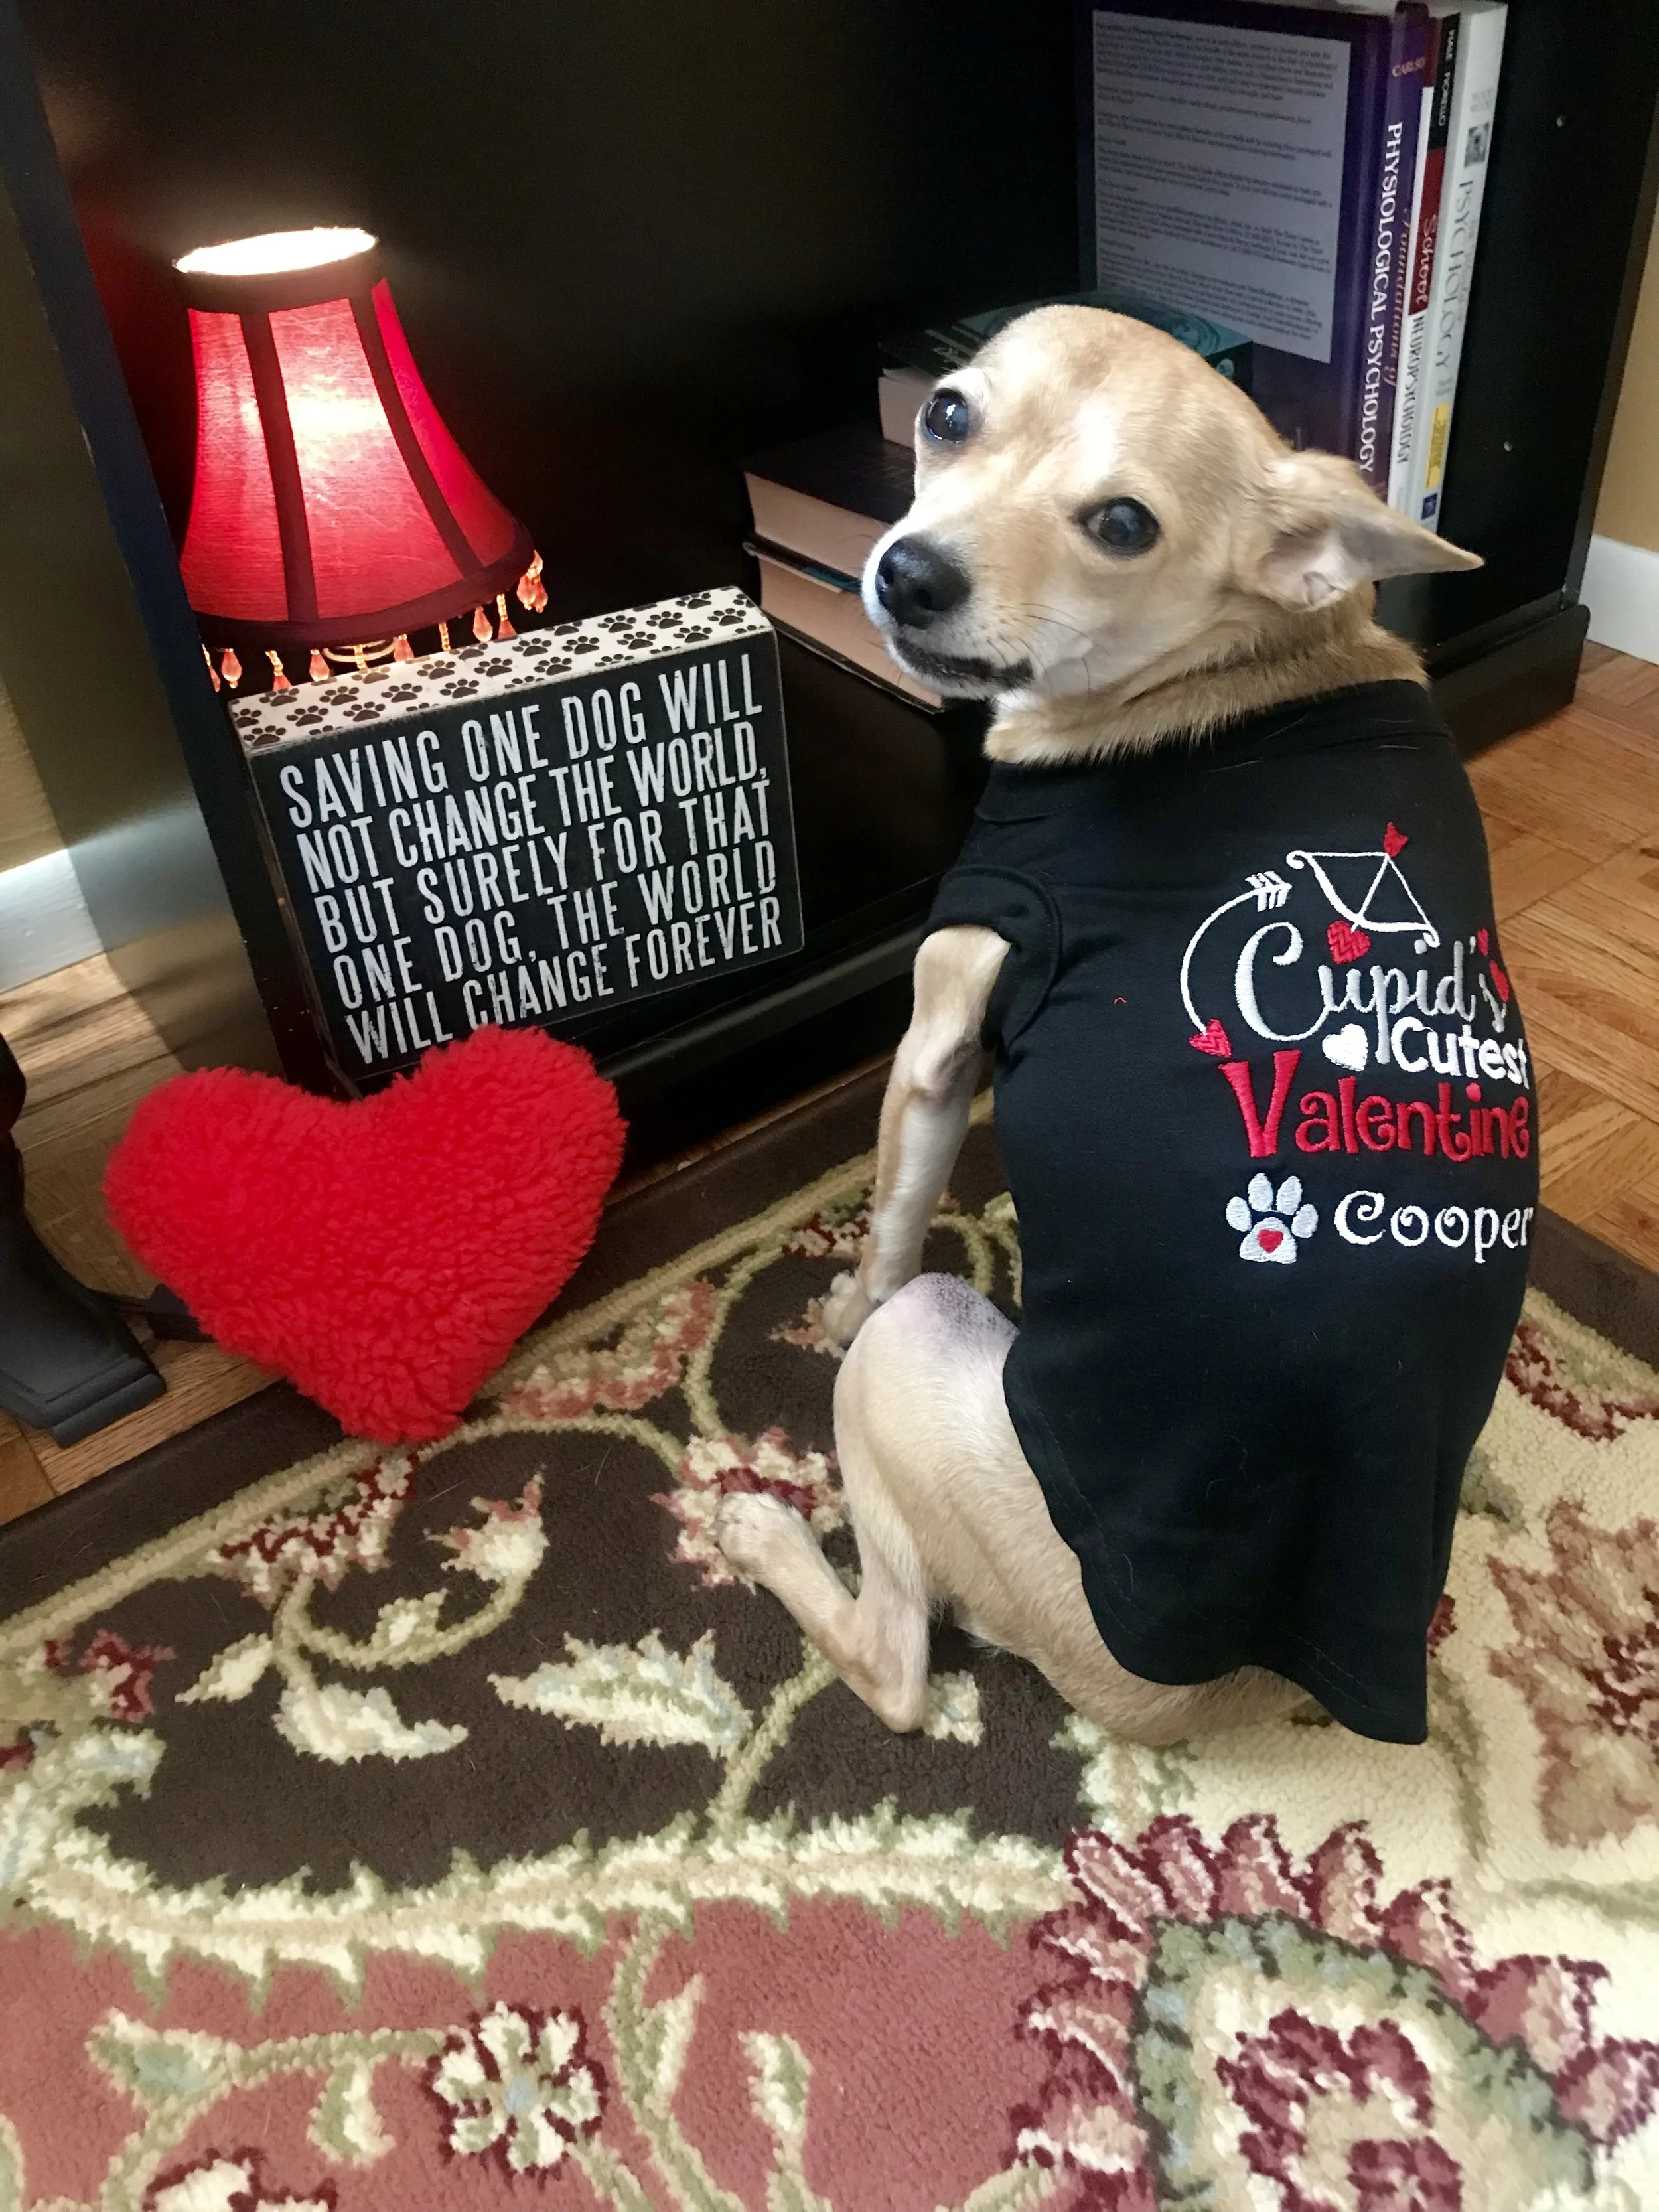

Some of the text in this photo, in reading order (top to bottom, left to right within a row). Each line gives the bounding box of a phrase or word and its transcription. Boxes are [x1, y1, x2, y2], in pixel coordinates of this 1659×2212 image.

[1370, 121, 1403, 321] PHYSIOLOGICAL
[1435, 180, 1473, 368] PSYCHOLOGY
[1359, 323, 1385, 473] PSYCHOLOGY
[1397, 214, 1437, 464] School NEUROPSYCHOLOGY
[280, 654, 762, 828] SAVING ONE DOG WILL
[296, 721, 767, 893] NOT CHANGE THE WORLD,
[315, 779, 772, 954] BUT SURELY FOR THAT
[332, 840, 778, 1009] ONE DOG, THE WORLD
[345, 897, 782, 1063] WILL CHANGE FOREVER
[1234, 921, 1507, 1065] Cupid's
[1392, 1016, 1530, 1090] Cutest
[1218, 1049, 1530, 1162] Valentine
[1333, 1189, 1534, 1264] Cooper
